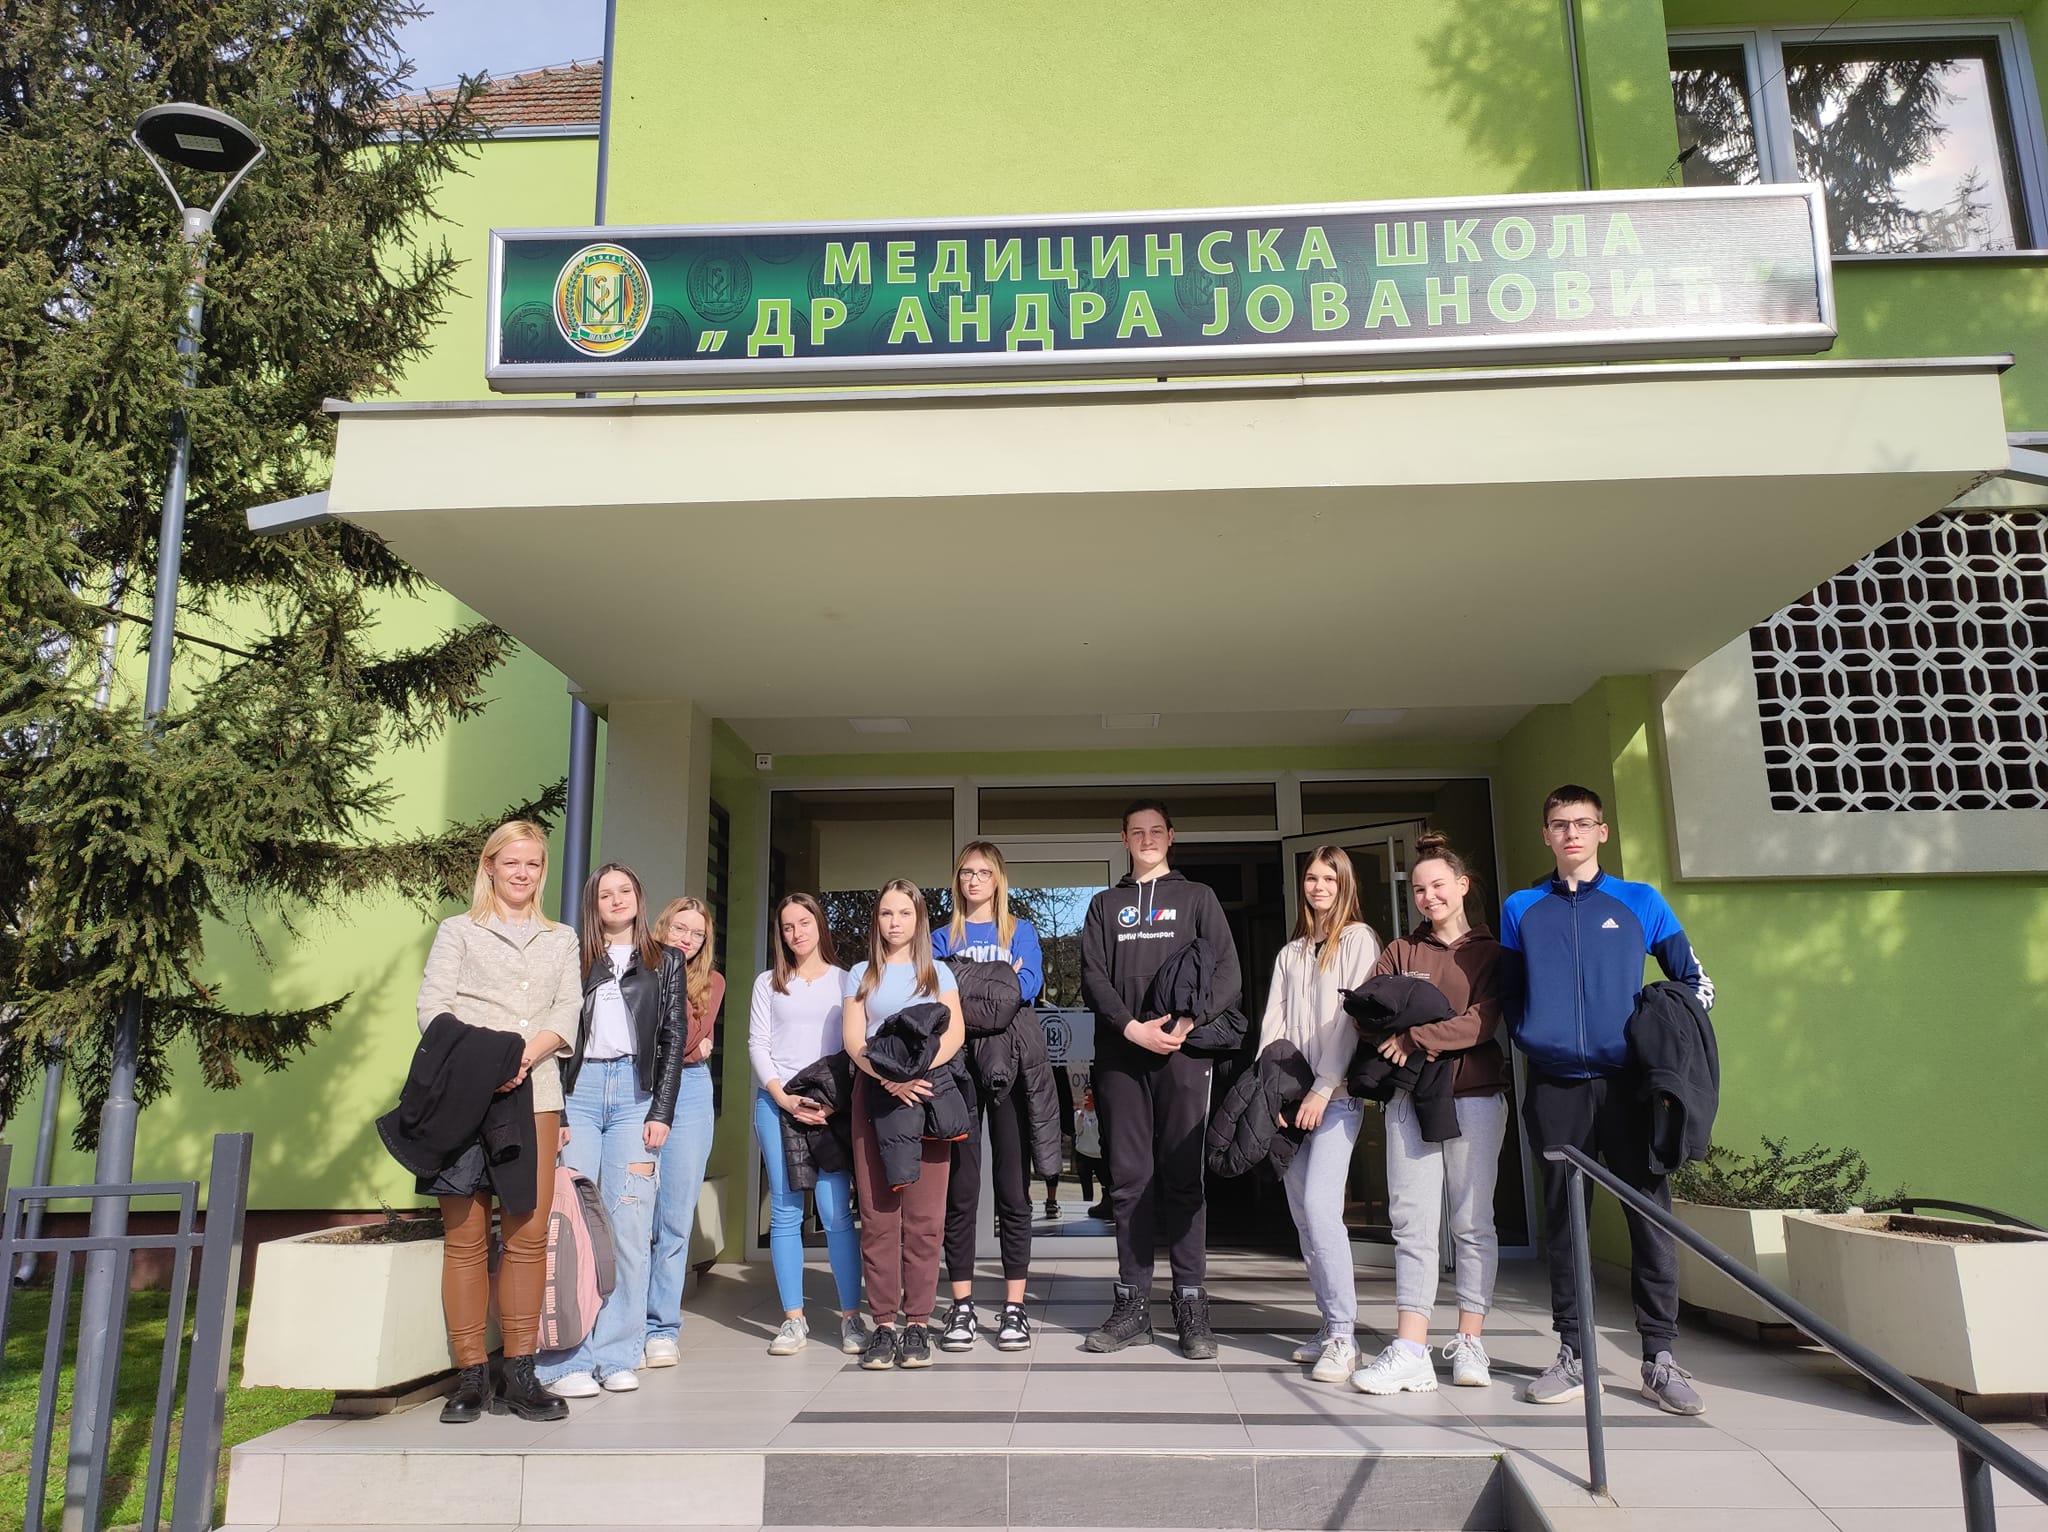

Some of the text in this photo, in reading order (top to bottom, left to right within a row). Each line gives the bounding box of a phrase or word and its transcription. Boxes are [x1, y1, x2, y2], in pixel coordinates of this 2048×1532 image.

[823, 212, 1644, 292] МЕДИЦИНСКА ШКОЛА
[889, 290, 1162, 352] АНДРА
[1118, 931, 1175, 942] BMW Motorsport
